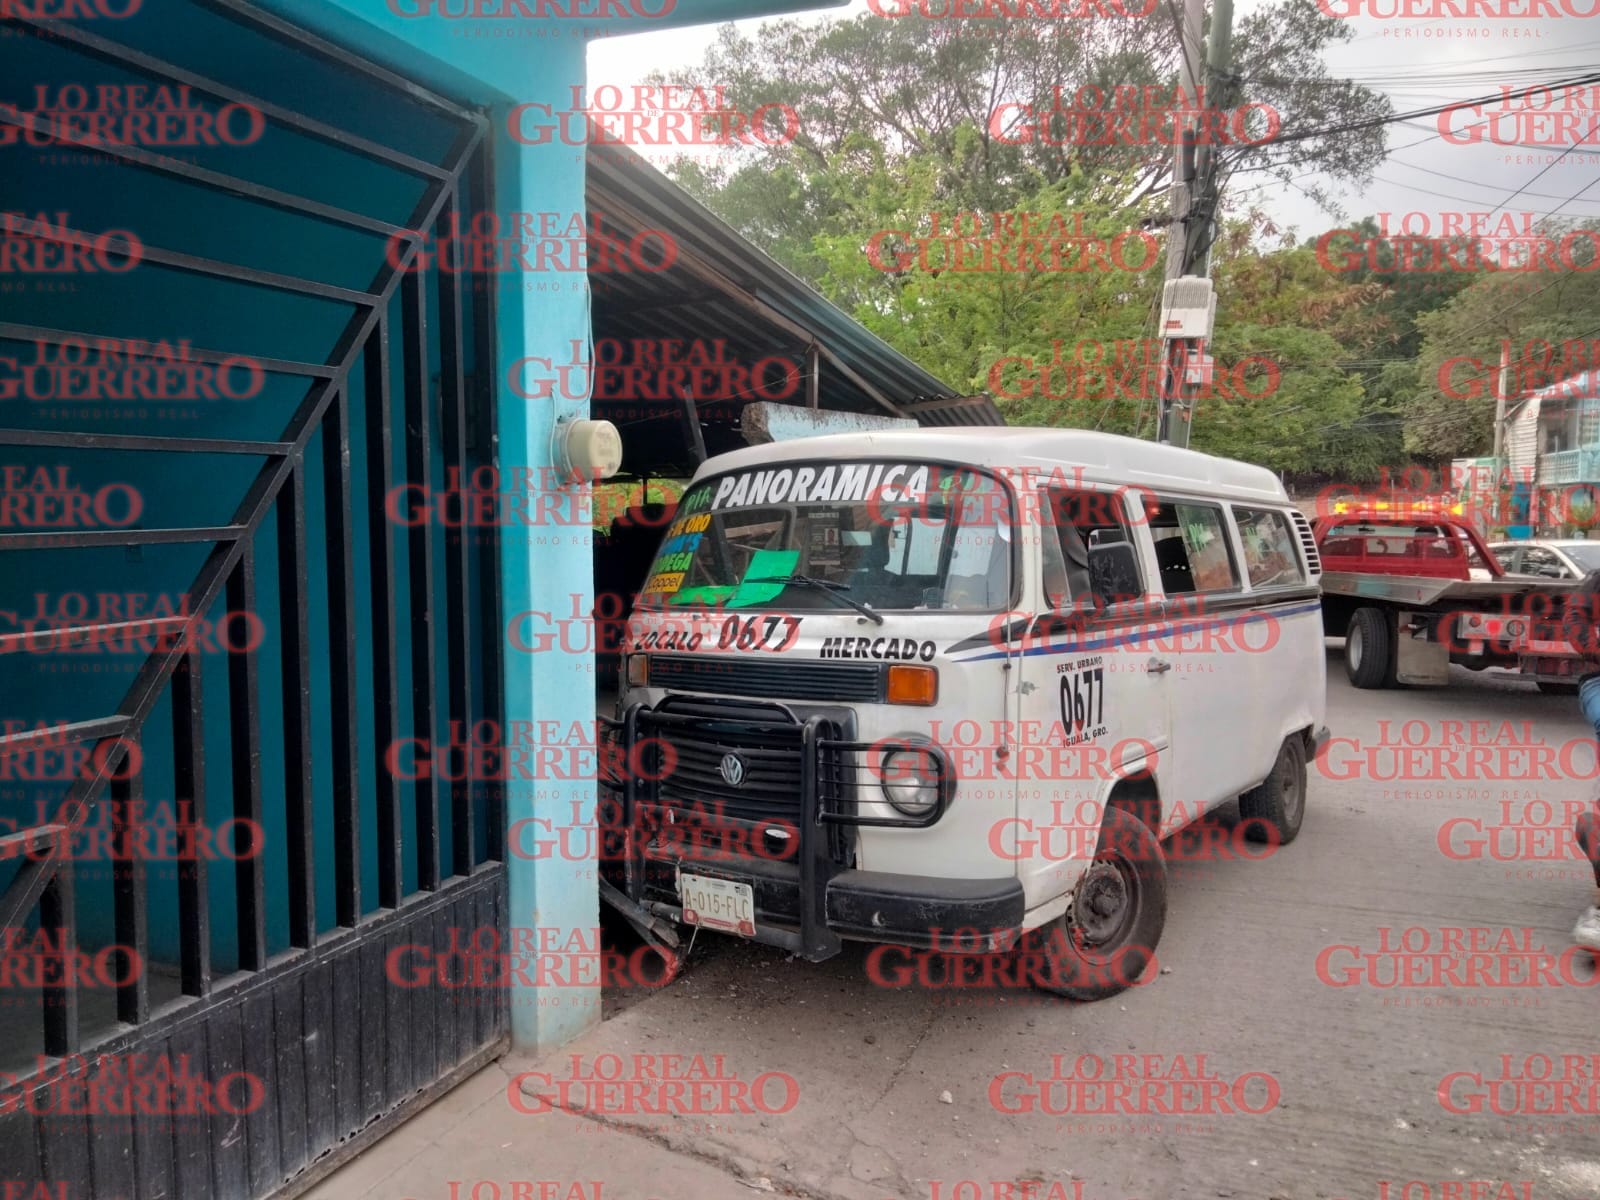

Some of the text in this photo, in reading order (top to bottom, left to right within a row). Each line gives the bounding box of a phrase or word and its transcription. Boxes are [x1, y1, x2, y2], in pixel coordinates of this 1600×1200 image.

[711, 464, 929, 510] PANORAMICA
[635, 614, 937, 662] ZOCALO 0677 MERCADO
[1056, 656, 1103, 674] SERV. URBANO
[1060, 667, 1104, 735] 0677
[685, 888, 749, 921] A-015-FLC
